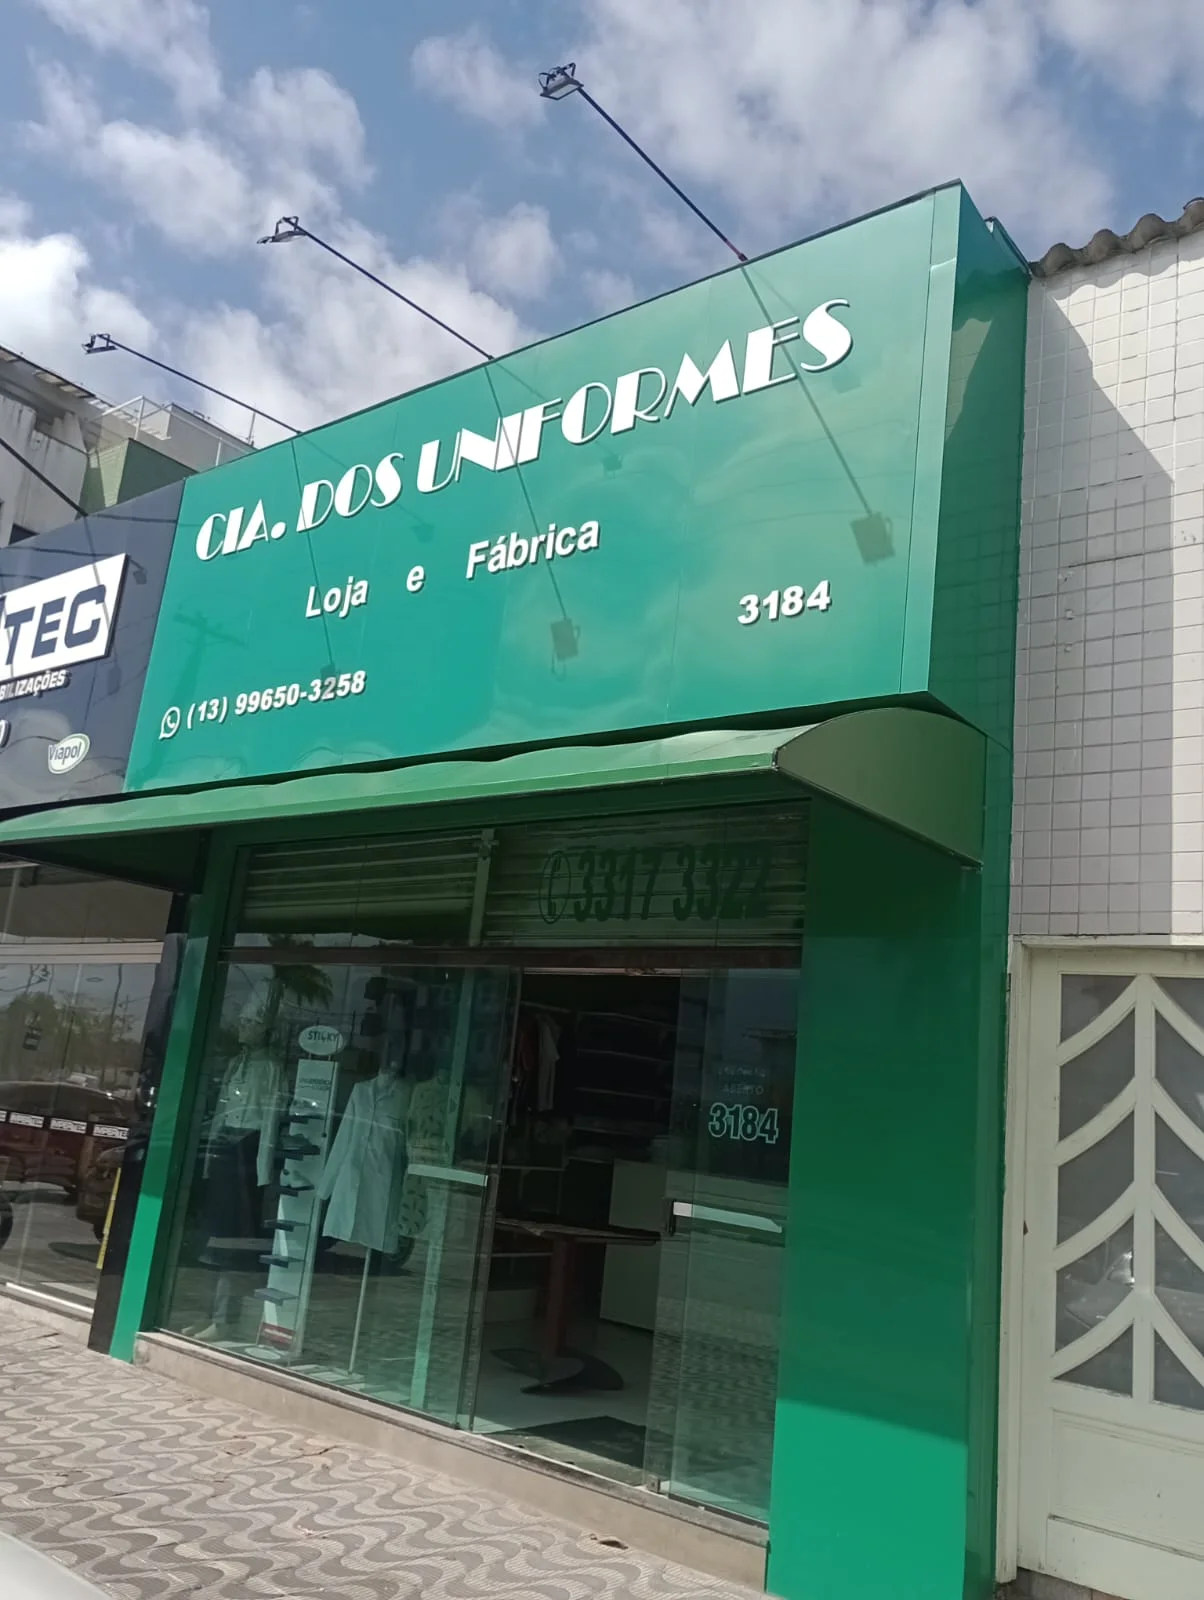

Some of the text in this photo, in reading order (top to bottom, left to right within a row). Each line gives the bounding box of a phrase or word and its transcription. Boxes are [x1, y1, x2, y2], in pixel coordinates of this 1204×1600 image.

[195, 298, 853, 562] CIA. DOS UNIFORMES
[305, 519, 600, 618] Loja e Fábrica
[0, 584, 106, 665] TEC
[737, 579, 832, 625] 3184
[186, 670, 367, 730] (13) 99650-3258
[49, 741, 82, 766] Viapol
[708, 1102, 779, 1144] 3184
